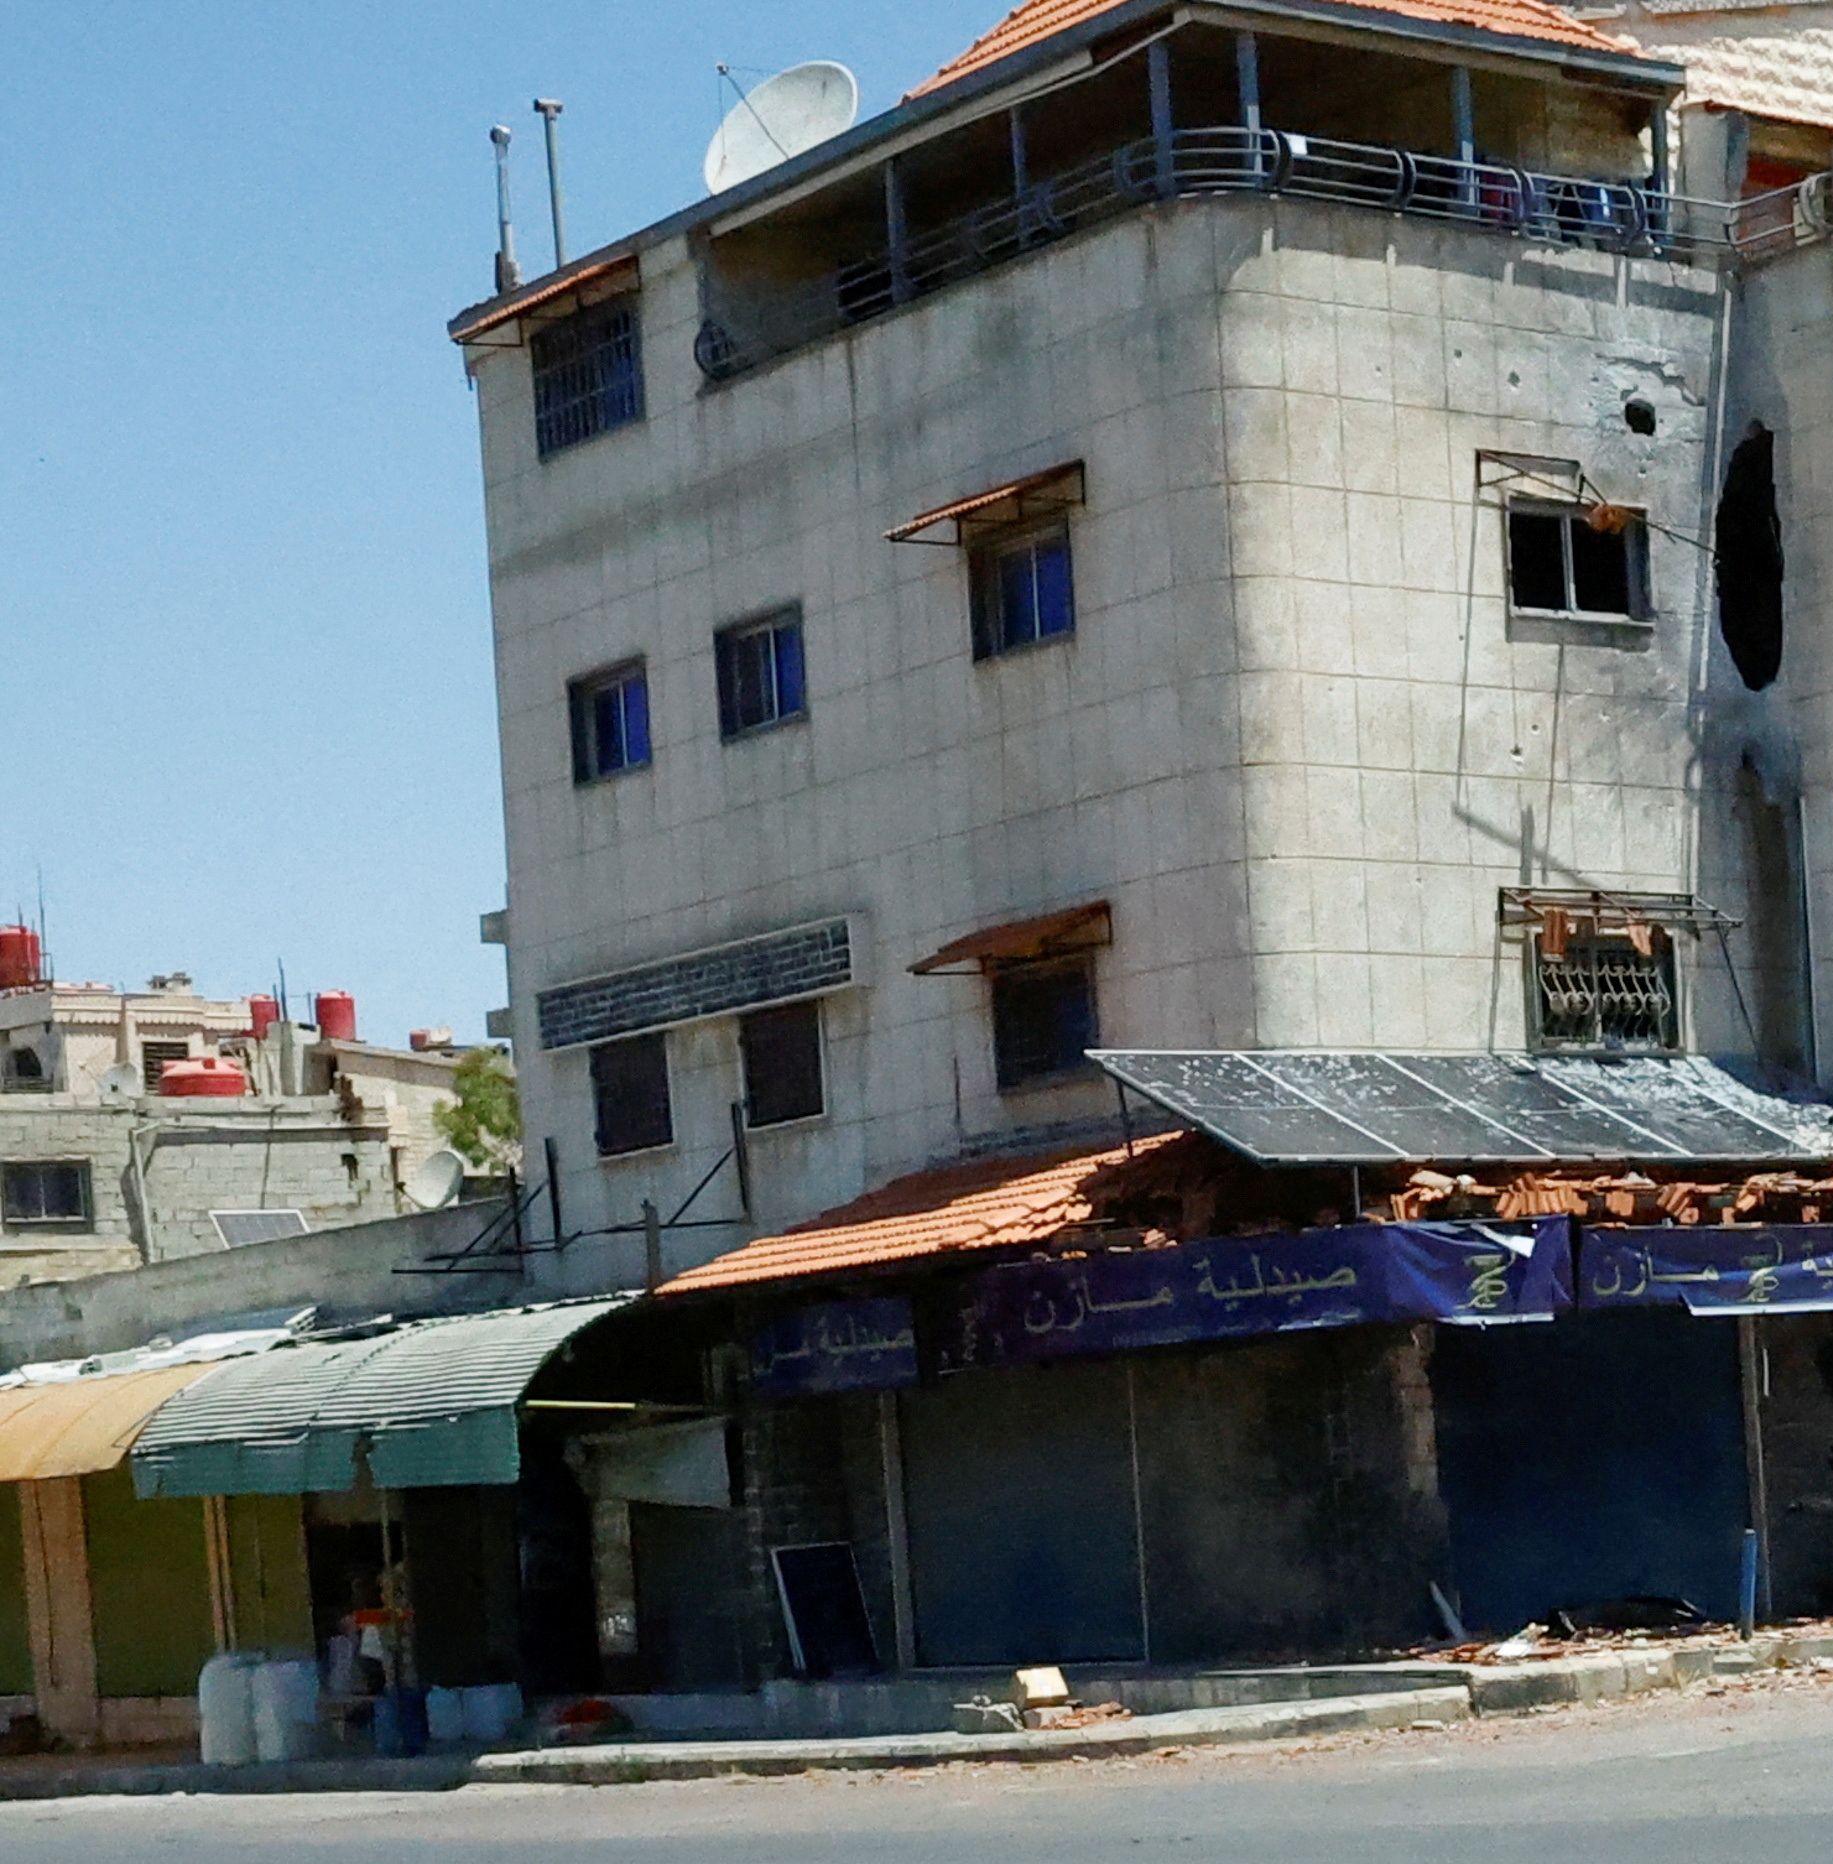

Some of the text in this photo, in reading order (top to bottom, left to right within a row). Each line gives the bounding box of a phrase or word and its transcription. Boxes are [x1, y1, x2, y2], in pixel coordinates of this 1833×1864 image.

[1023, 1253, 1357, 1335] صيدلية مازن
[1593, 1246, 1720, 1297] مازن
